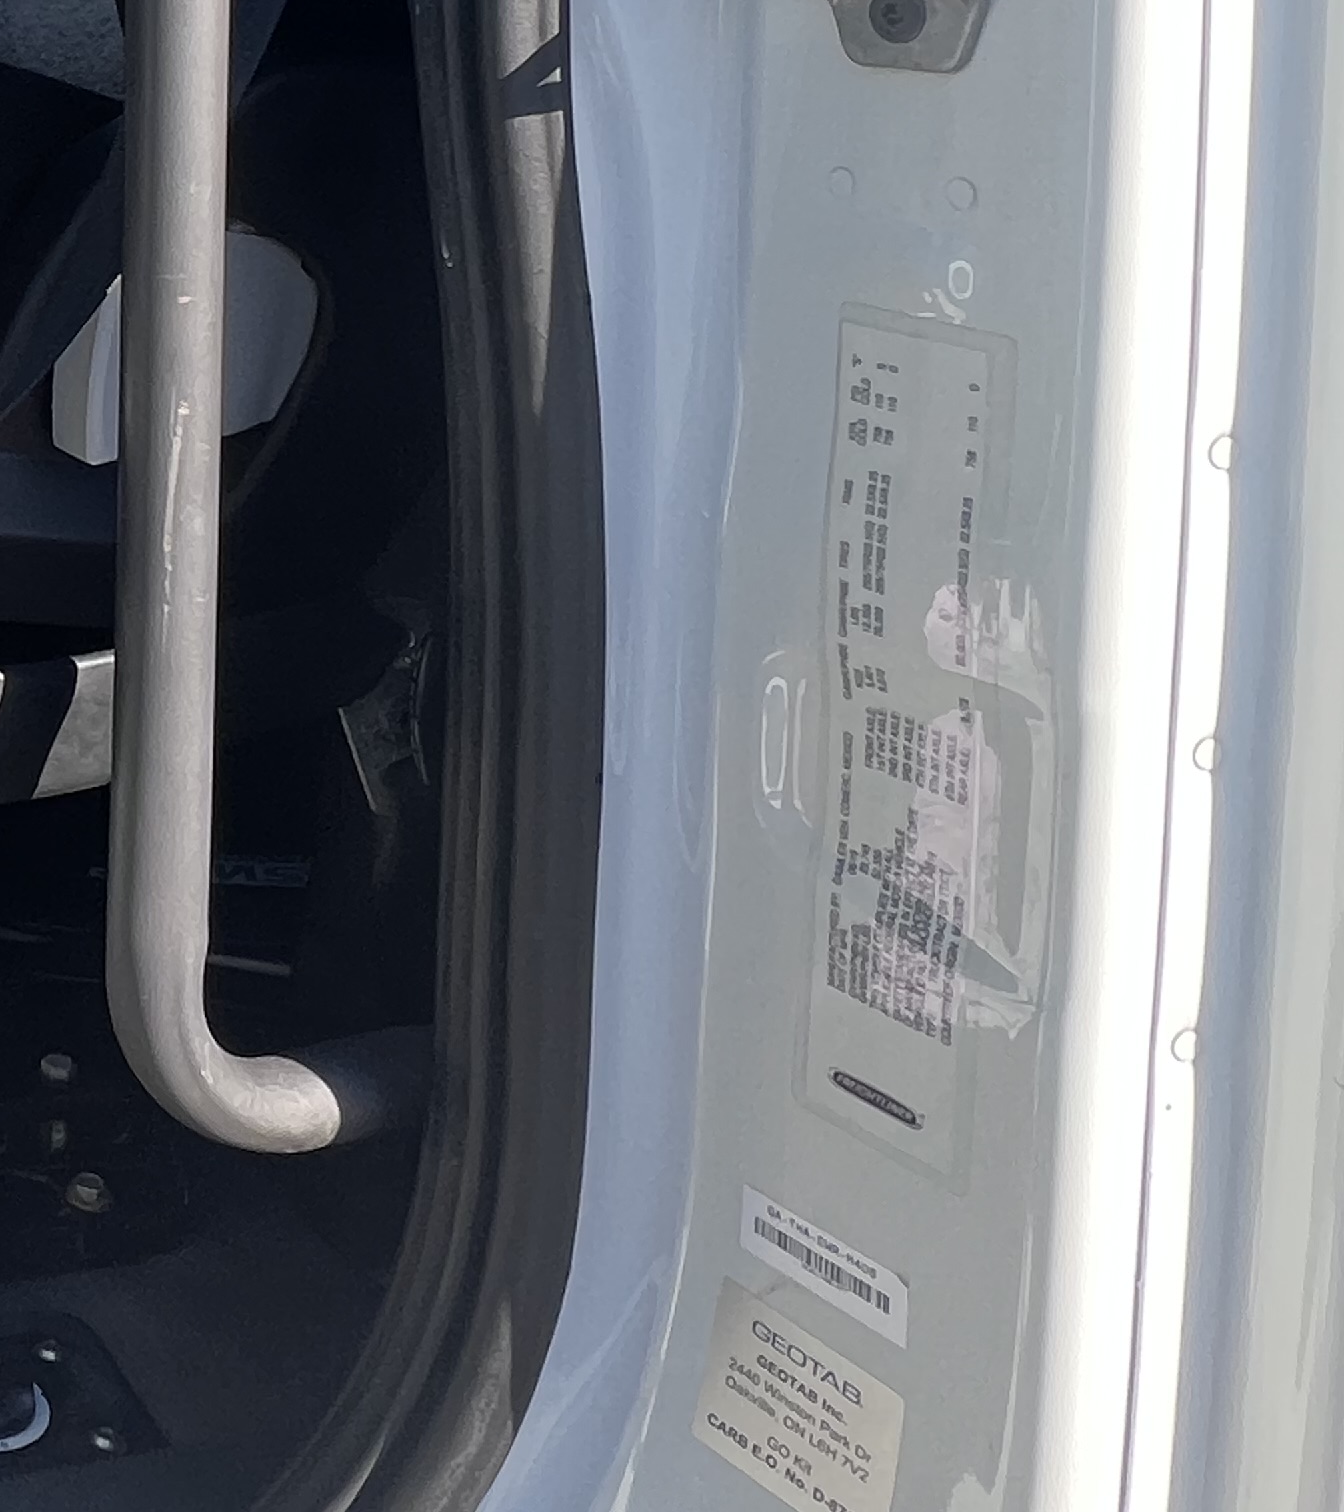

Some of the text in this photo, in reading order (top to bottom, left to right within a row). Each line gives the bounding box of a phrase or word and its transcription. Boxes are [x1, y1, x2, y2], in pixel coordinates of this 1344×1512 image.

[752, 1320, 863, 1407] GEOTAB
[756, 1354, 848, 1426] GEOTAB Inc.
[706, 1413, 748, 1449] CARB
[766, 1436, 790, 1459] GO
